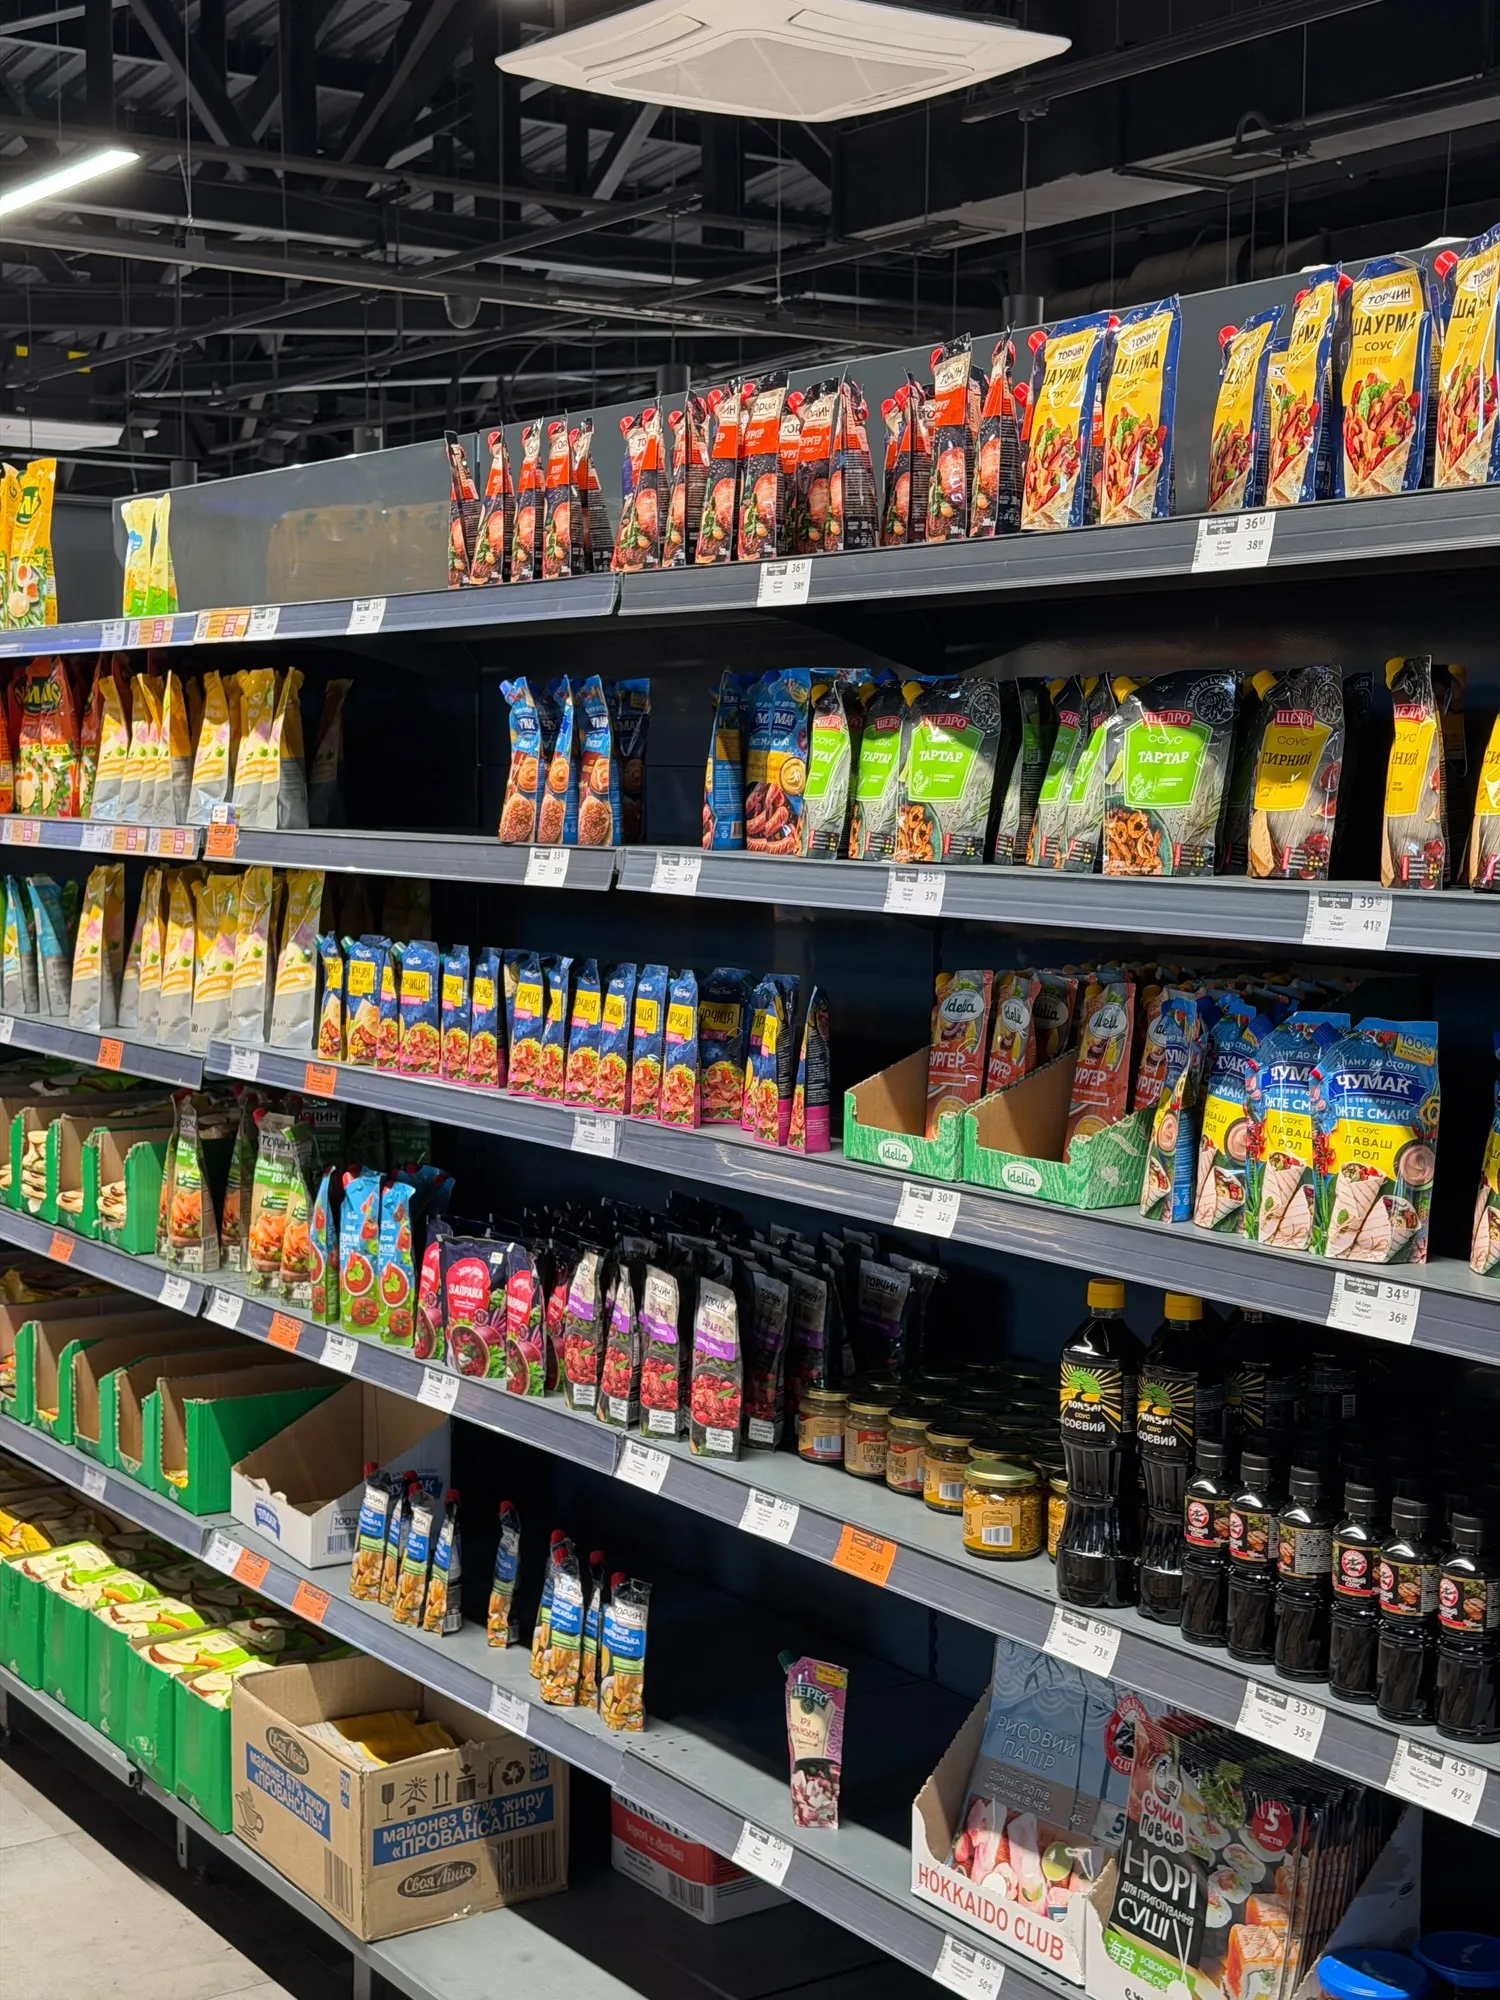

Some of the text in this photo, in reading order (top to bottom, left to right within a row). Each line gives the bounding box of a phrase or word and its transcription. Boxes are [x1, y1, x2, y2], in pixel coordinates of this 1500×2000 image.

[1368, 287, 1411, 305] ТОРЧИН
[1364, 341, 1393, 352] СОУС
[1245, 518, 1258, 529] 36
[1247, 540, 1257, 550] 38
[1060, 713, 1080, 727] ЕДРО
[1144, 712, 1190, 725] ЩЕДРО
[1148, 734, 1183, 744] СОУС
[1278, 735, 1308, 746] СОУС
[920, 749, 963, 762] ТАРТАР
[1137, 751, 1190, 765] ТАРТАР
[1262, 750, 1313, 767] СИРНИЙ
[1392, 751, 1418, 766] НИЙ
[924, 872, 933, 882] 35
[925, 891, 933, 900] 37
[1360, 896, 1374, 908] 39
[1363, 920, 1374, 930] 41
[402, 977, 426, 991] РЧИЦЯ
[945, 999, 977, 1013] Idelia
[988, 1057, 1011, 1078] УРГЕР
[1270, 1065, 1310, 1082] ЧУМ
[1386, 1061, 1417, 1072] СТОЛУ
[1074, 1066, 1107, 1087] УРГЕР
[1336, 1074, 1412, 1094] ЧУМАК
[1335, 1104, 1410, 1120] ЇЖТЕ СМАК!
[1282, 1116, 1304, 1125] СОУС
[1271, 1125, 1313, 1139] ЛАВАШ
[1357, 1126, 1380, 1135] СОУС
[1278, 1139, 1302, 1150] РОЛ
[1344, 1135, 1393, 1149] ЛАВАШ
[882, 1145, 908, 1163] Idelia
[1353, 1149, 1379, 1160] РОЛ
[271, 1170, 290, 1184] 28%
[1007, 1170, 1036, 1188] Idelia
[937, 1192, 947, 1203] 30
[937, 1212, 945, 1221] 32
[866, 1275, 899, 1293] ТОРЧИН
[449, 1283, 483, 1300] ЗАПРАВКА
[1386, 1287, 1400, 1300] 34
[1388, 1311, 1400, 1323] 36
[1064, 1418, 1106, 1433] СОЄВИЙ
[1139, 1430, 1177, 1447] СОЄВИЙ
[651, 1452, 660, 1462] 39
[778, 1518, 785, 1528] 27
[870, 1562, 880, 1573] 28
[1345, 1581, 1361, 1589] СОУС
[1094, 1623, 1106, 1636] 69
[1093, 1645, 1104, 1657] 73
[1294, 1701, 1308, 1716] 33
[996, 1715, 1077, 1757] РИСОВИЙ
[1293, 1725, 1306, 1738] 35
[1002, 1740, 1056, 1771] ПАПІР
[1113, 1757, 1134, 1774] CLU
[1451, 1761, 1466, 1777] 45
[250, 1750, 327, 1818] майонез 67% жиру
[1451, 1787, 1464, 1800] 47
[254, 1770, 323, 1832] «ПРОВАНСАЛЬ»
[383, 1792, 546, 1844] майонез 67% жиру
[1112, 1813, 1125, 1834] 5
[1264, 1807, 1281, 1833] 5
[392, 1811, 537, 1858] «ПРОВАНСАЛЬ»
[404, 1862, 473, 1897] Своя Лінія
[1124, 1840, 1197, 1909] НОРІ
[1121, 1881, 1194, 1928] ДЛЯ ПРИГОТУВАННЯ
[918, 1863, 1064, 1961] HOKKAIDO CLUB
[1118, 1898, 1170, 1941] СУШІ
[1107, 1938, 1135, 1970] 海苔
[979, 1956, 991, 1970] 48
[977, 1978, 988, 1990] 50
